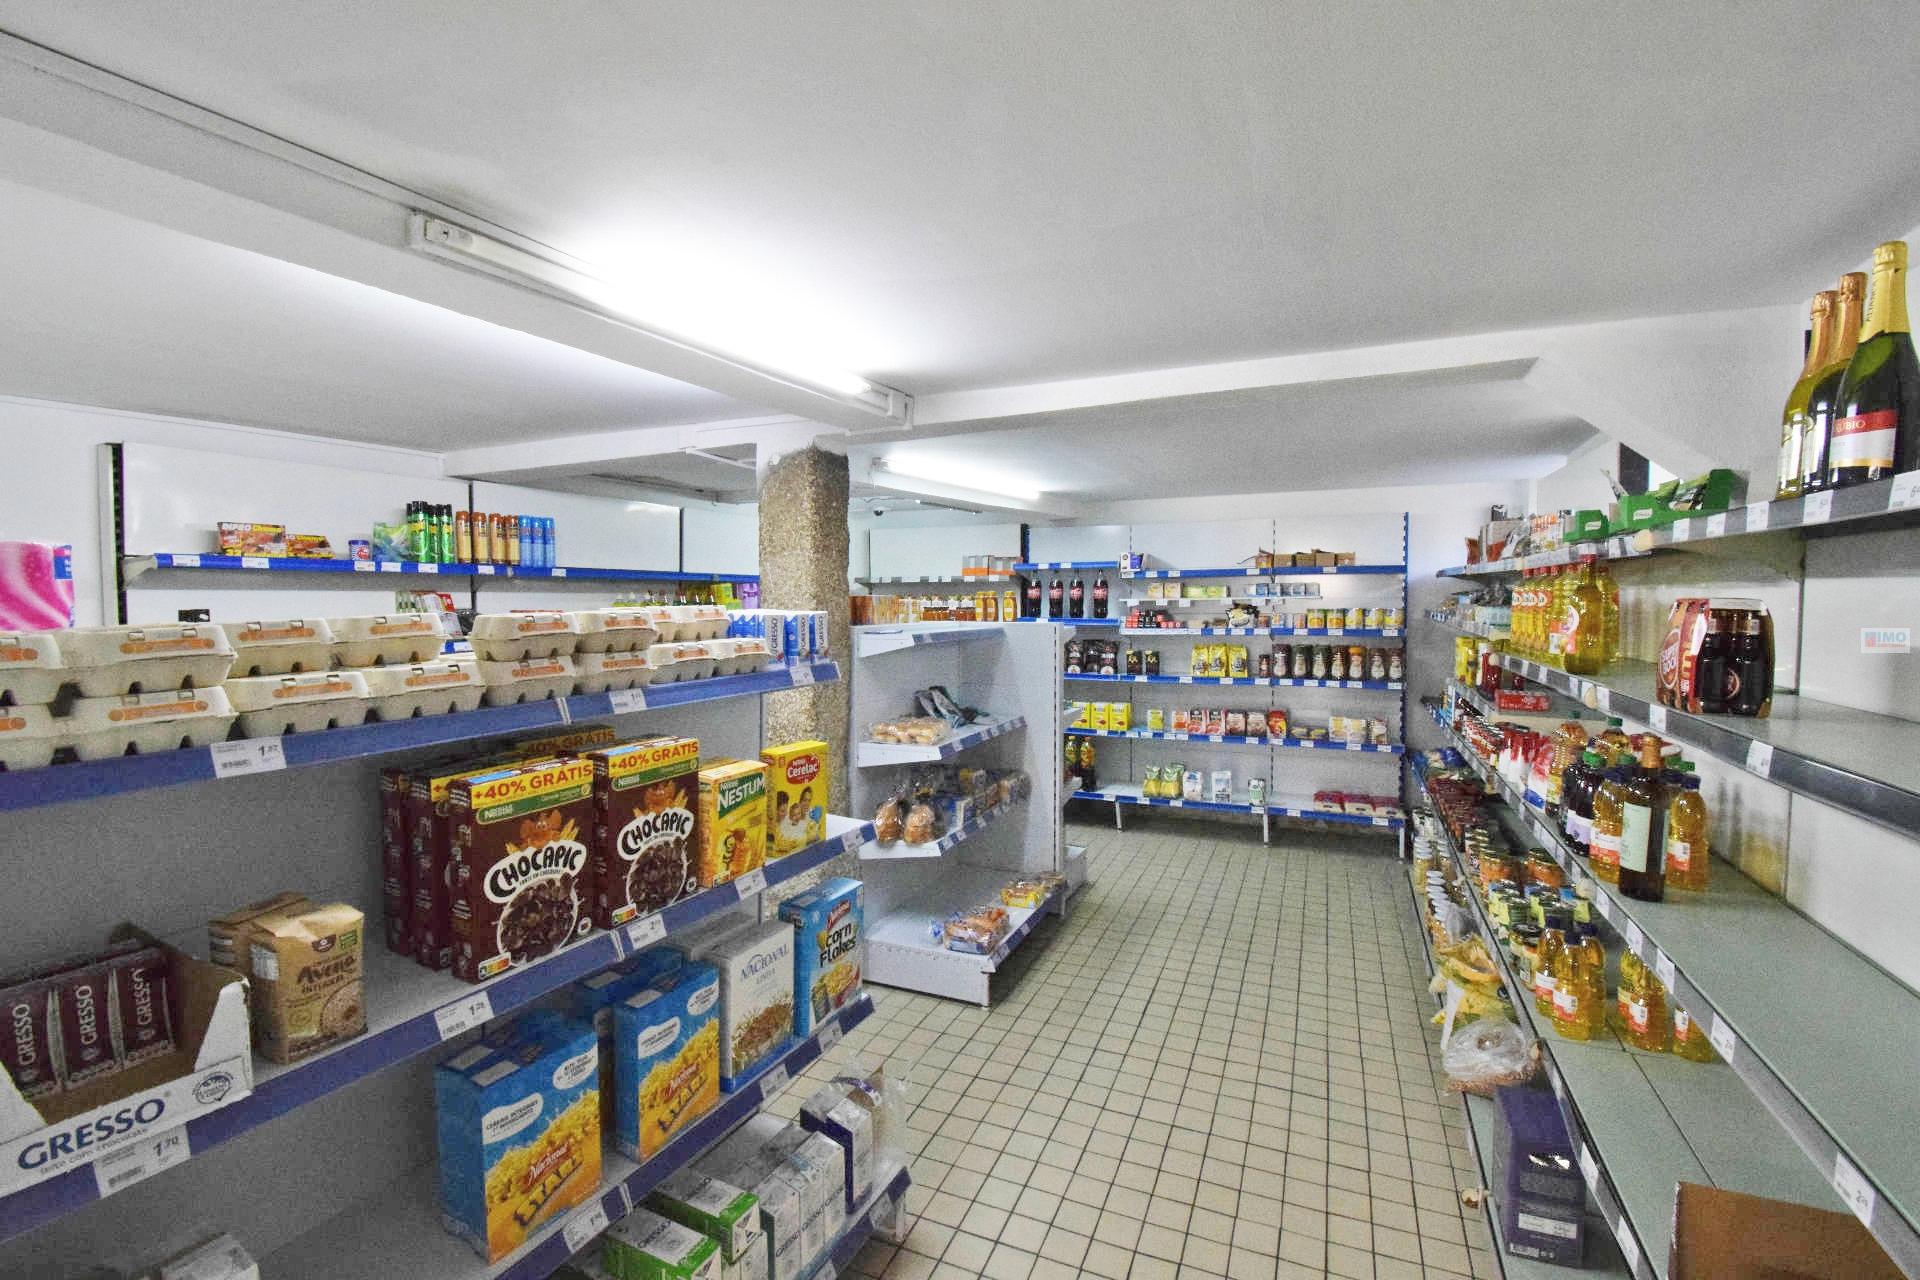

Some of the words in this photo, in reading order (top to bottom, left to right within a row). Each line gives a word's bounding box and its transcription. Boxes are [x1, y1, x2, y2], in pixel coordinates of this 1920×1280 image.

[717, 775, 766, 810] NESTUM
[787, 762, 819, 779] Cerelac
[620, 810, 691, 856] CHOCAPIC
[489, 843, 585, 898] CHOCAPIC
[12, 1003, 38, 1067] GRESSO
[75, 983, 98, 1046] GRESSO
[17, 1097, 166, 1170] GRESSO
